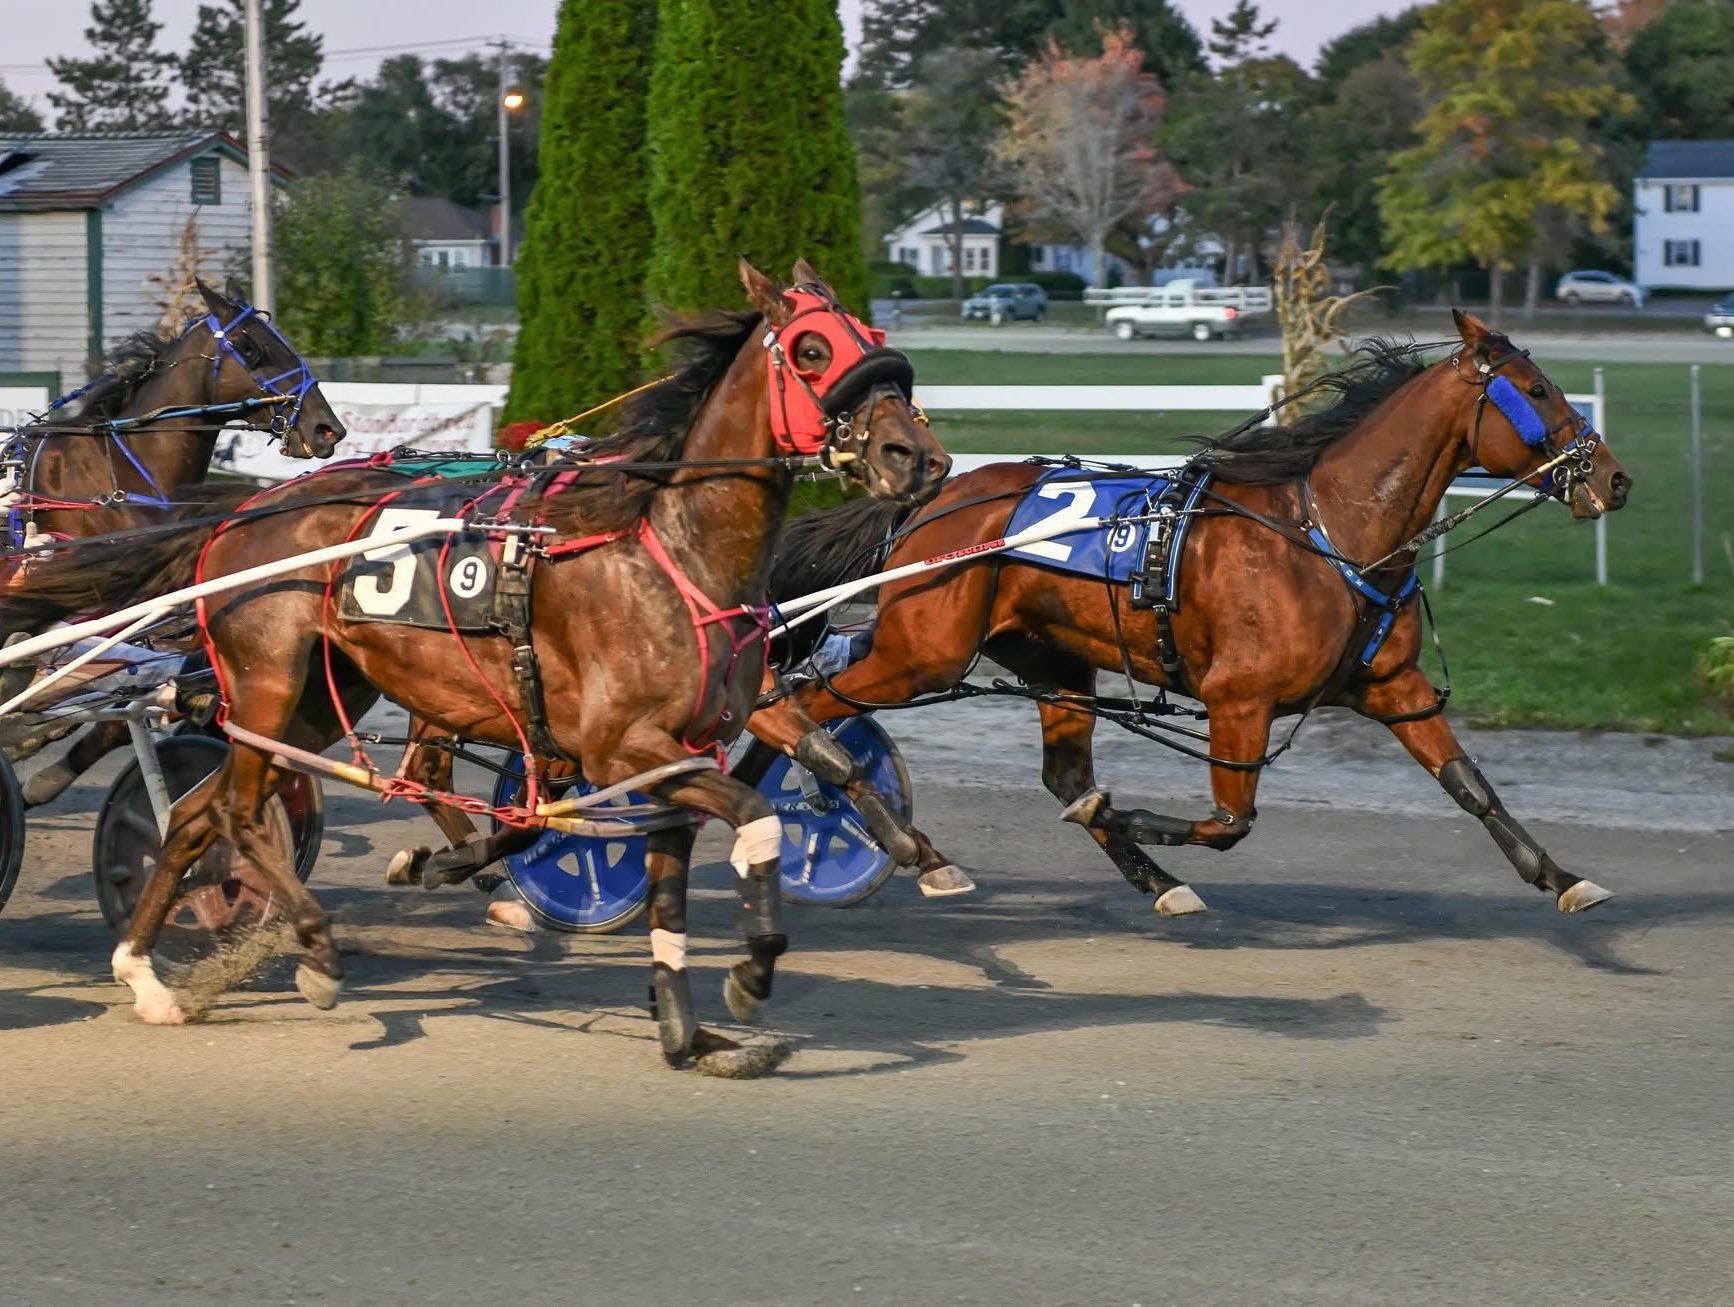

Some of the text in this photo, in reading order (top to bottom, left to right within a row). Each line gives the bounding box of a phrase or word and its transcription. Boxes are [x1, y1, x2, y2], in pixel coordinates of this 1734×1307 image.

[1013, 481, 1096, 562] 2
[1114, 524, 1131, 547] 9
[353, 508, 440, 615] 5
[460, 561, 478, 591] 9
